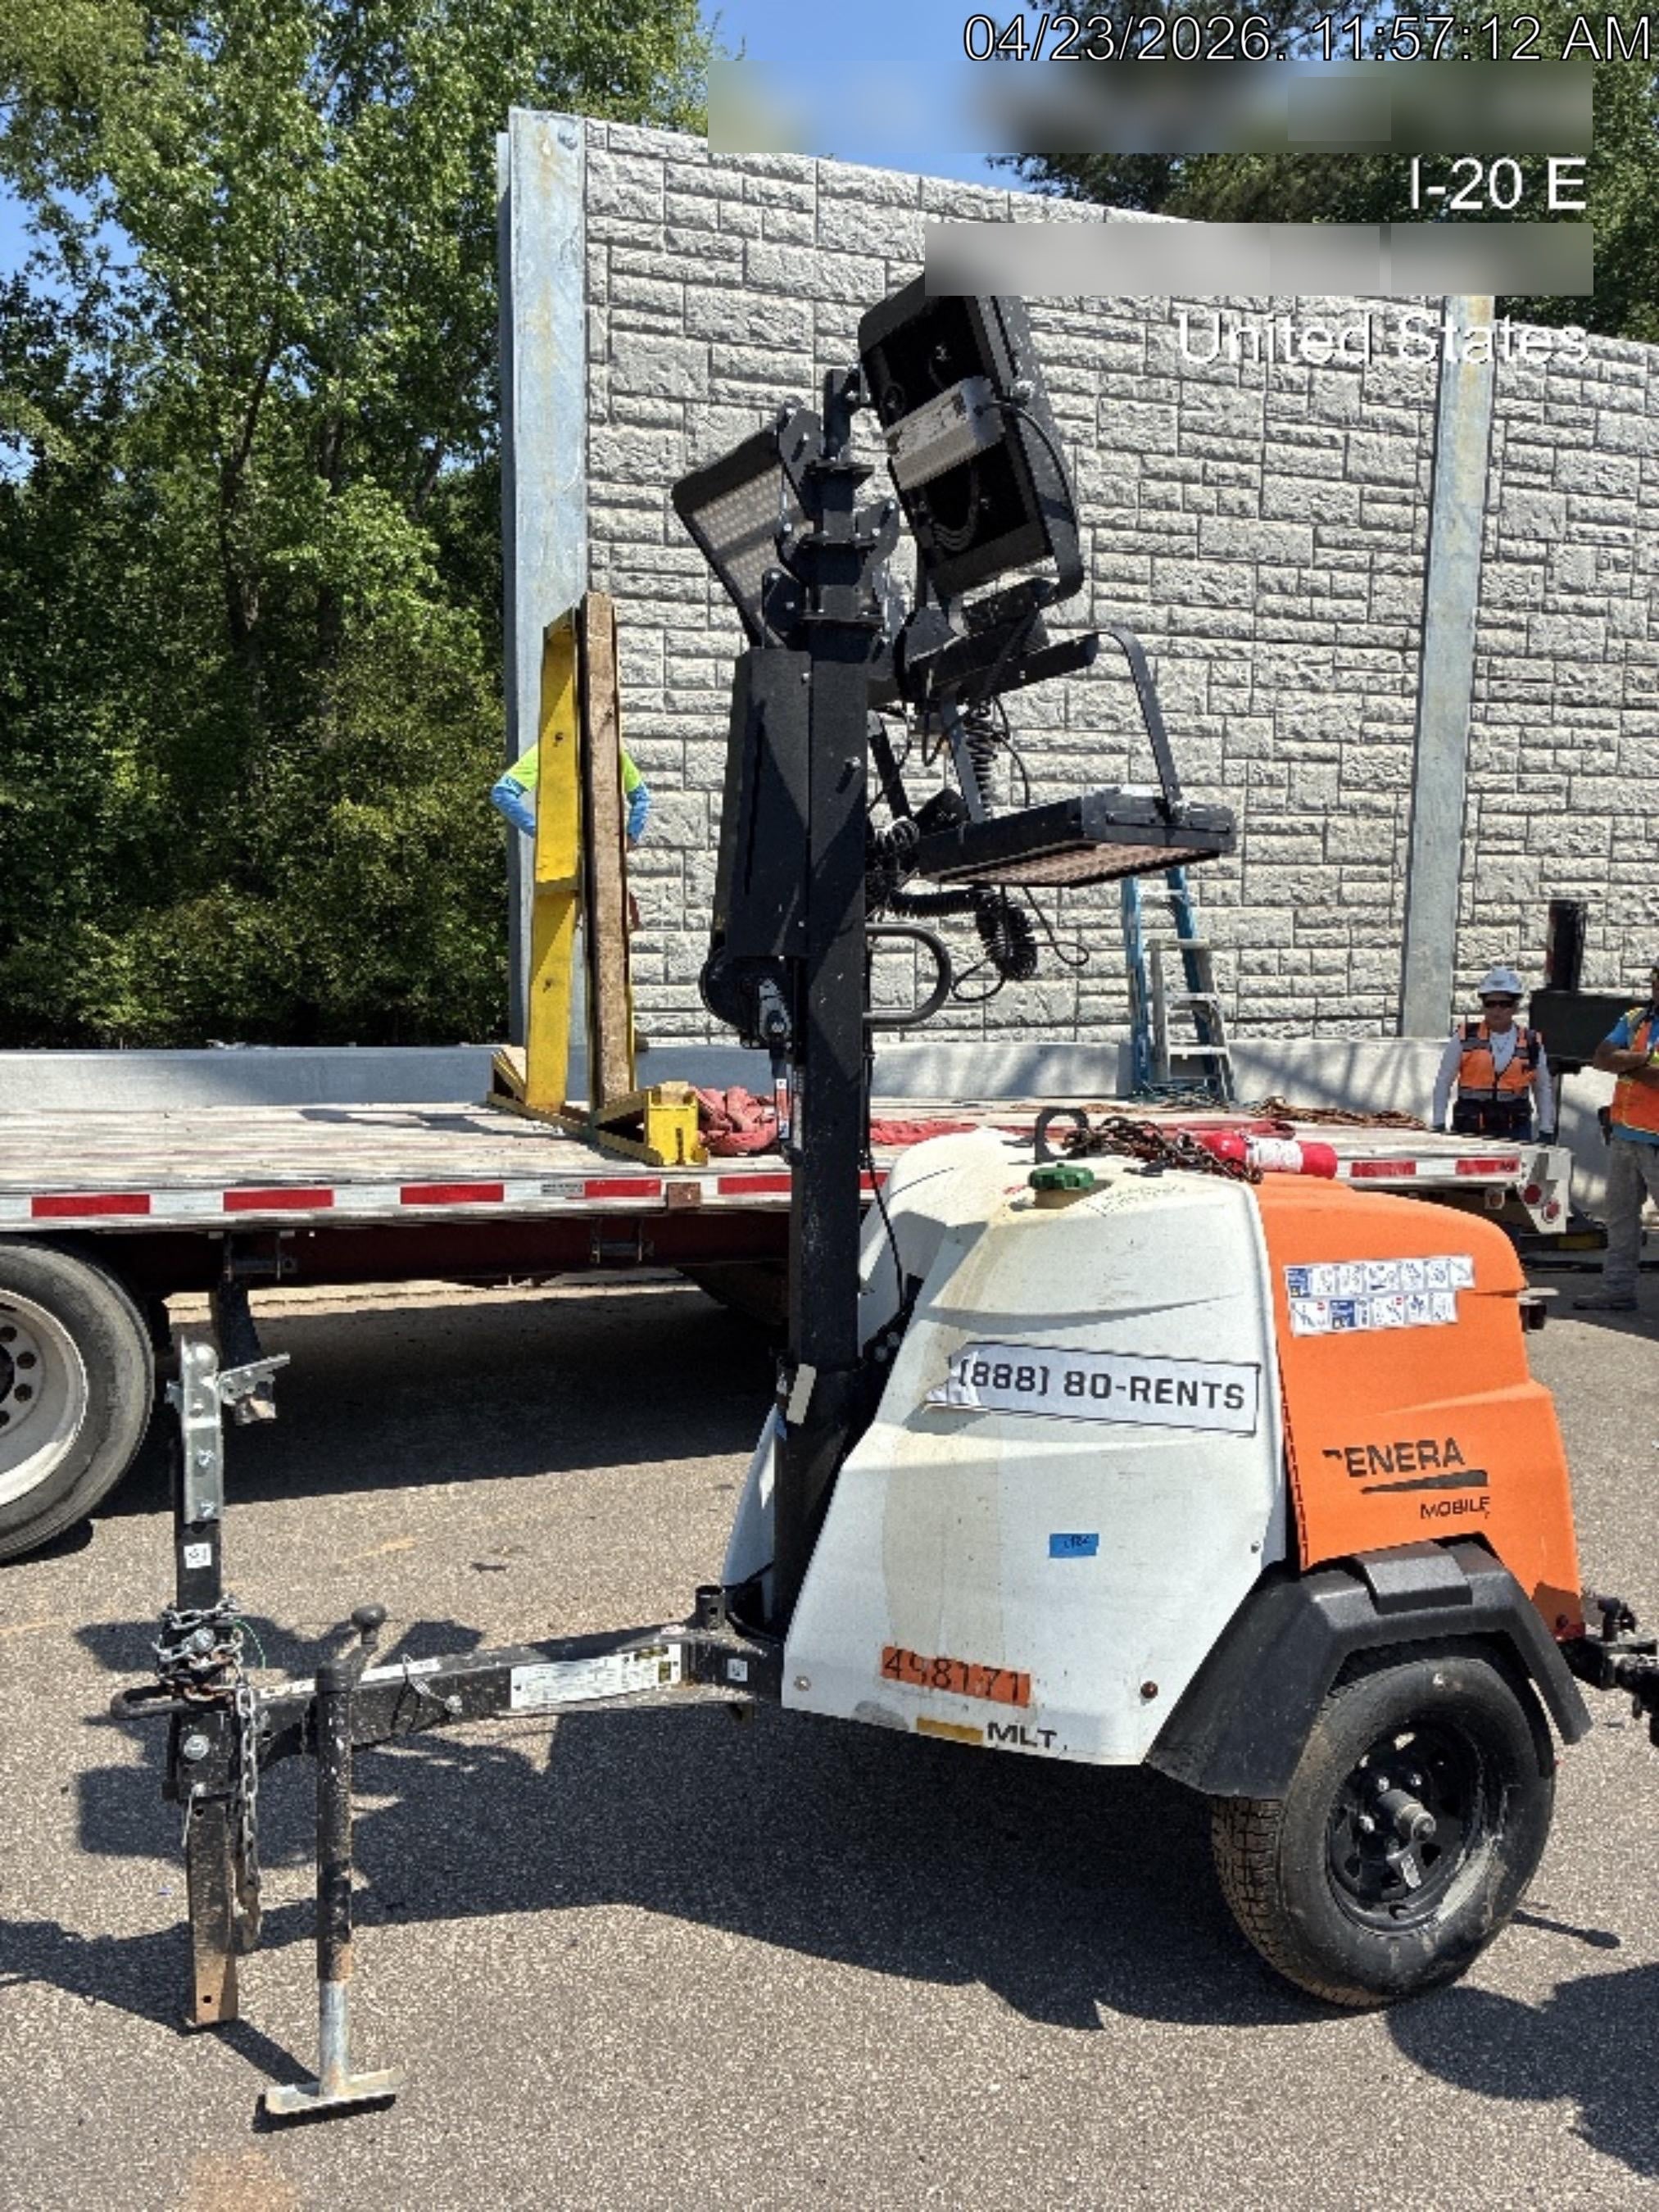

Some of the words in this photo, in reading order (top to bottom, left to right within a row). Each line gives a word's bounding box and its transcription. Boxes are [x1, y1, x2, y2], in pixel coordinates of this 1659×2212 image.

[959, 1358, 1049, 1396] (888)
[1063, 1371, 1244, 1410] 80-RENTS
[987, 1722, 1057, 1748] MLT
